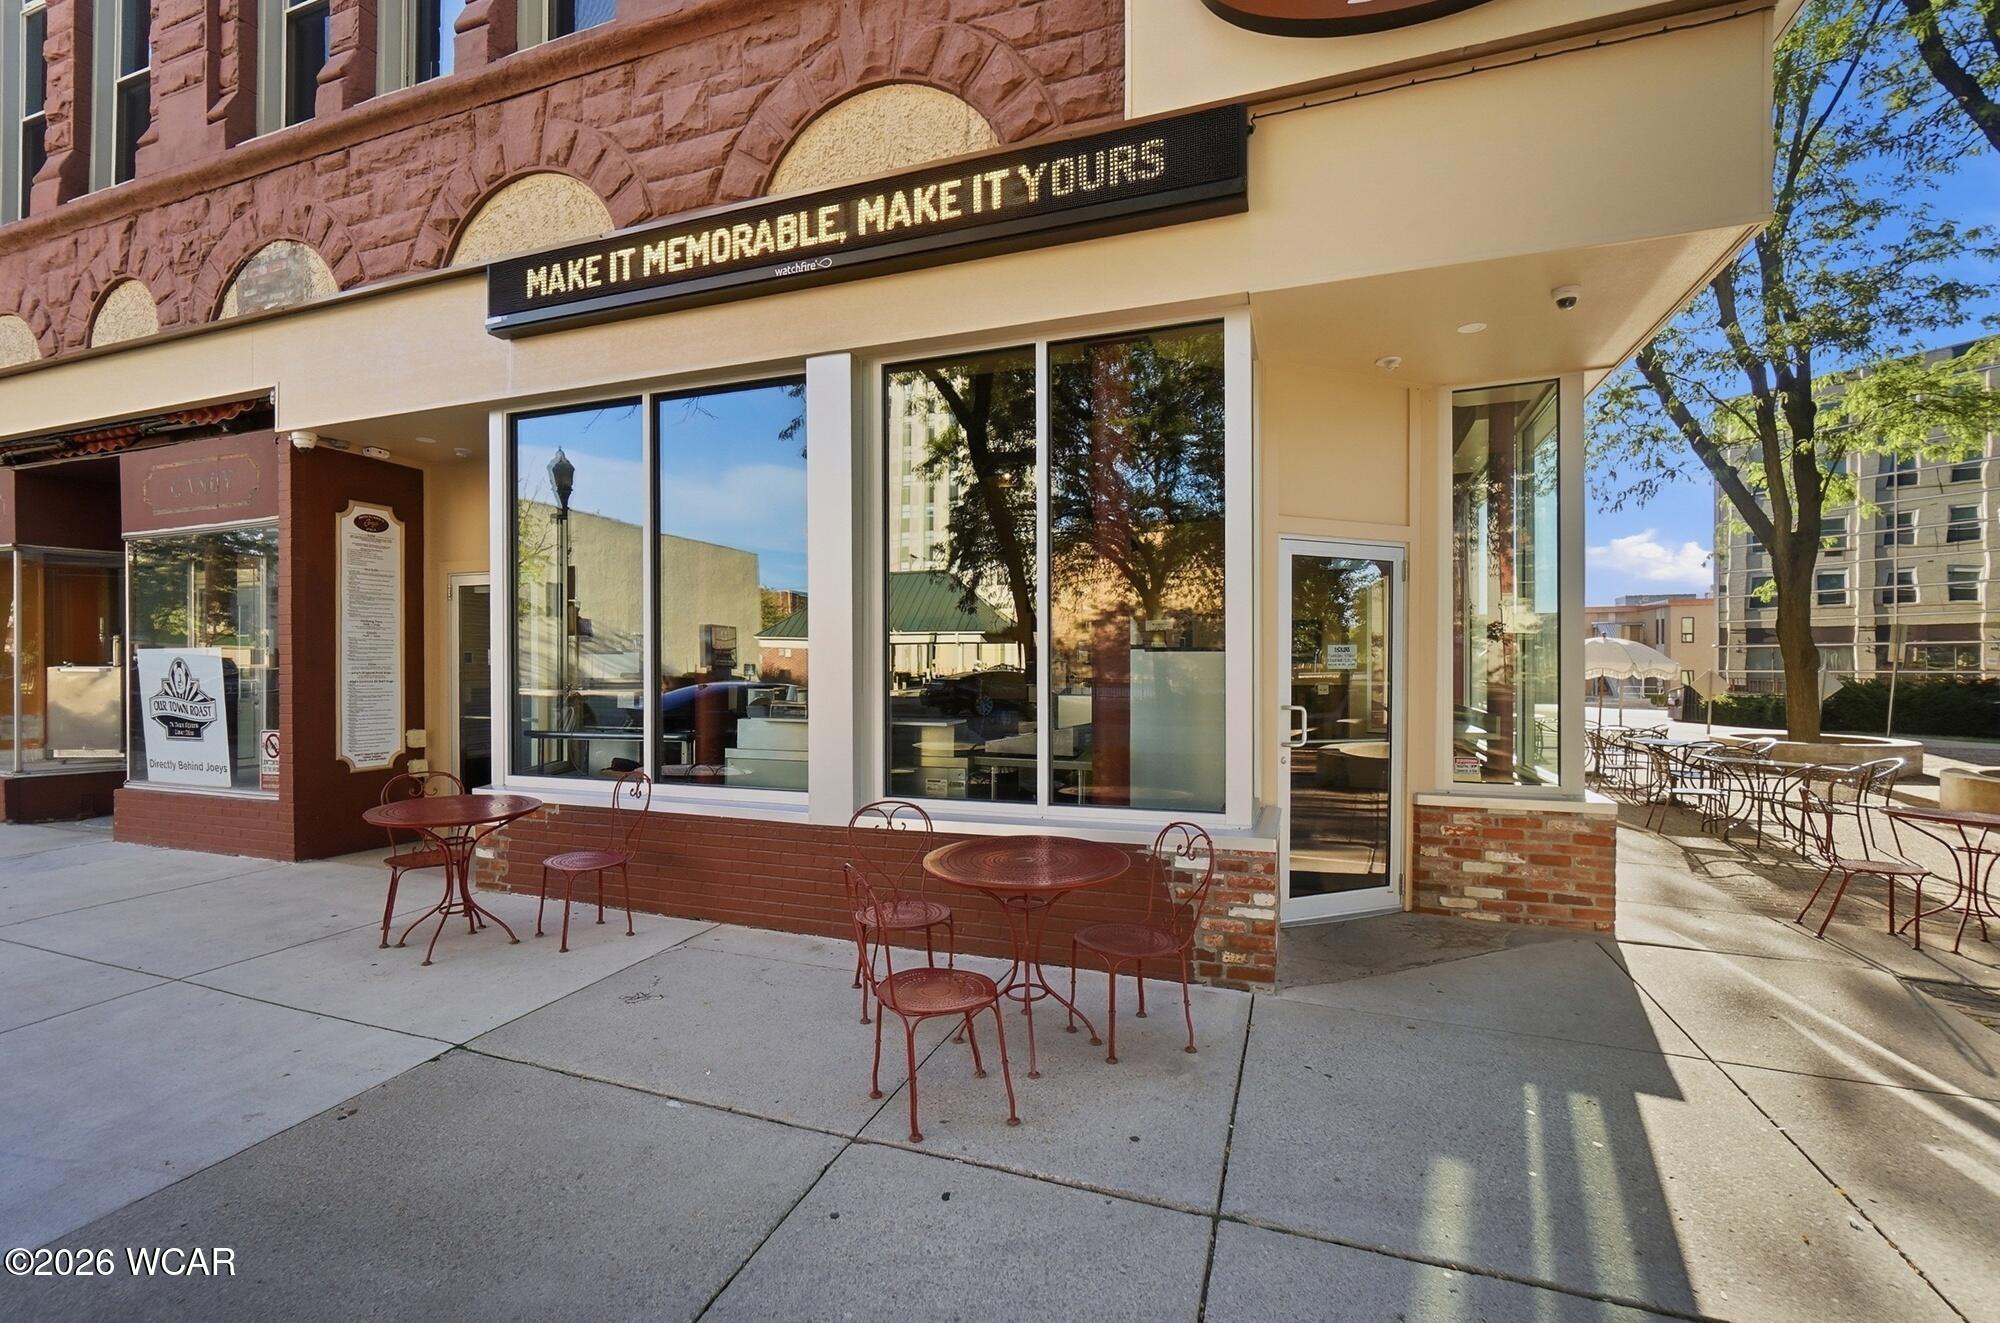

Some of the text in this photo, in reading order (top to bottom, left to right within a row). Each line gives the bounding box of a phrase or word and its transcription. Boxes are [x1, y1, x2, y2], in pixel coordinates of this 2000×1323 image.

[526, 138, 1165, 299] MAKE IT MEMORABLE, MAKE IT YOURS
[774, 261, 816, 276] watchfire
[153, 700, 212, 717] OUR TOWN ROAST
[149, 758, 228, 775] Directly Behind Joeys
